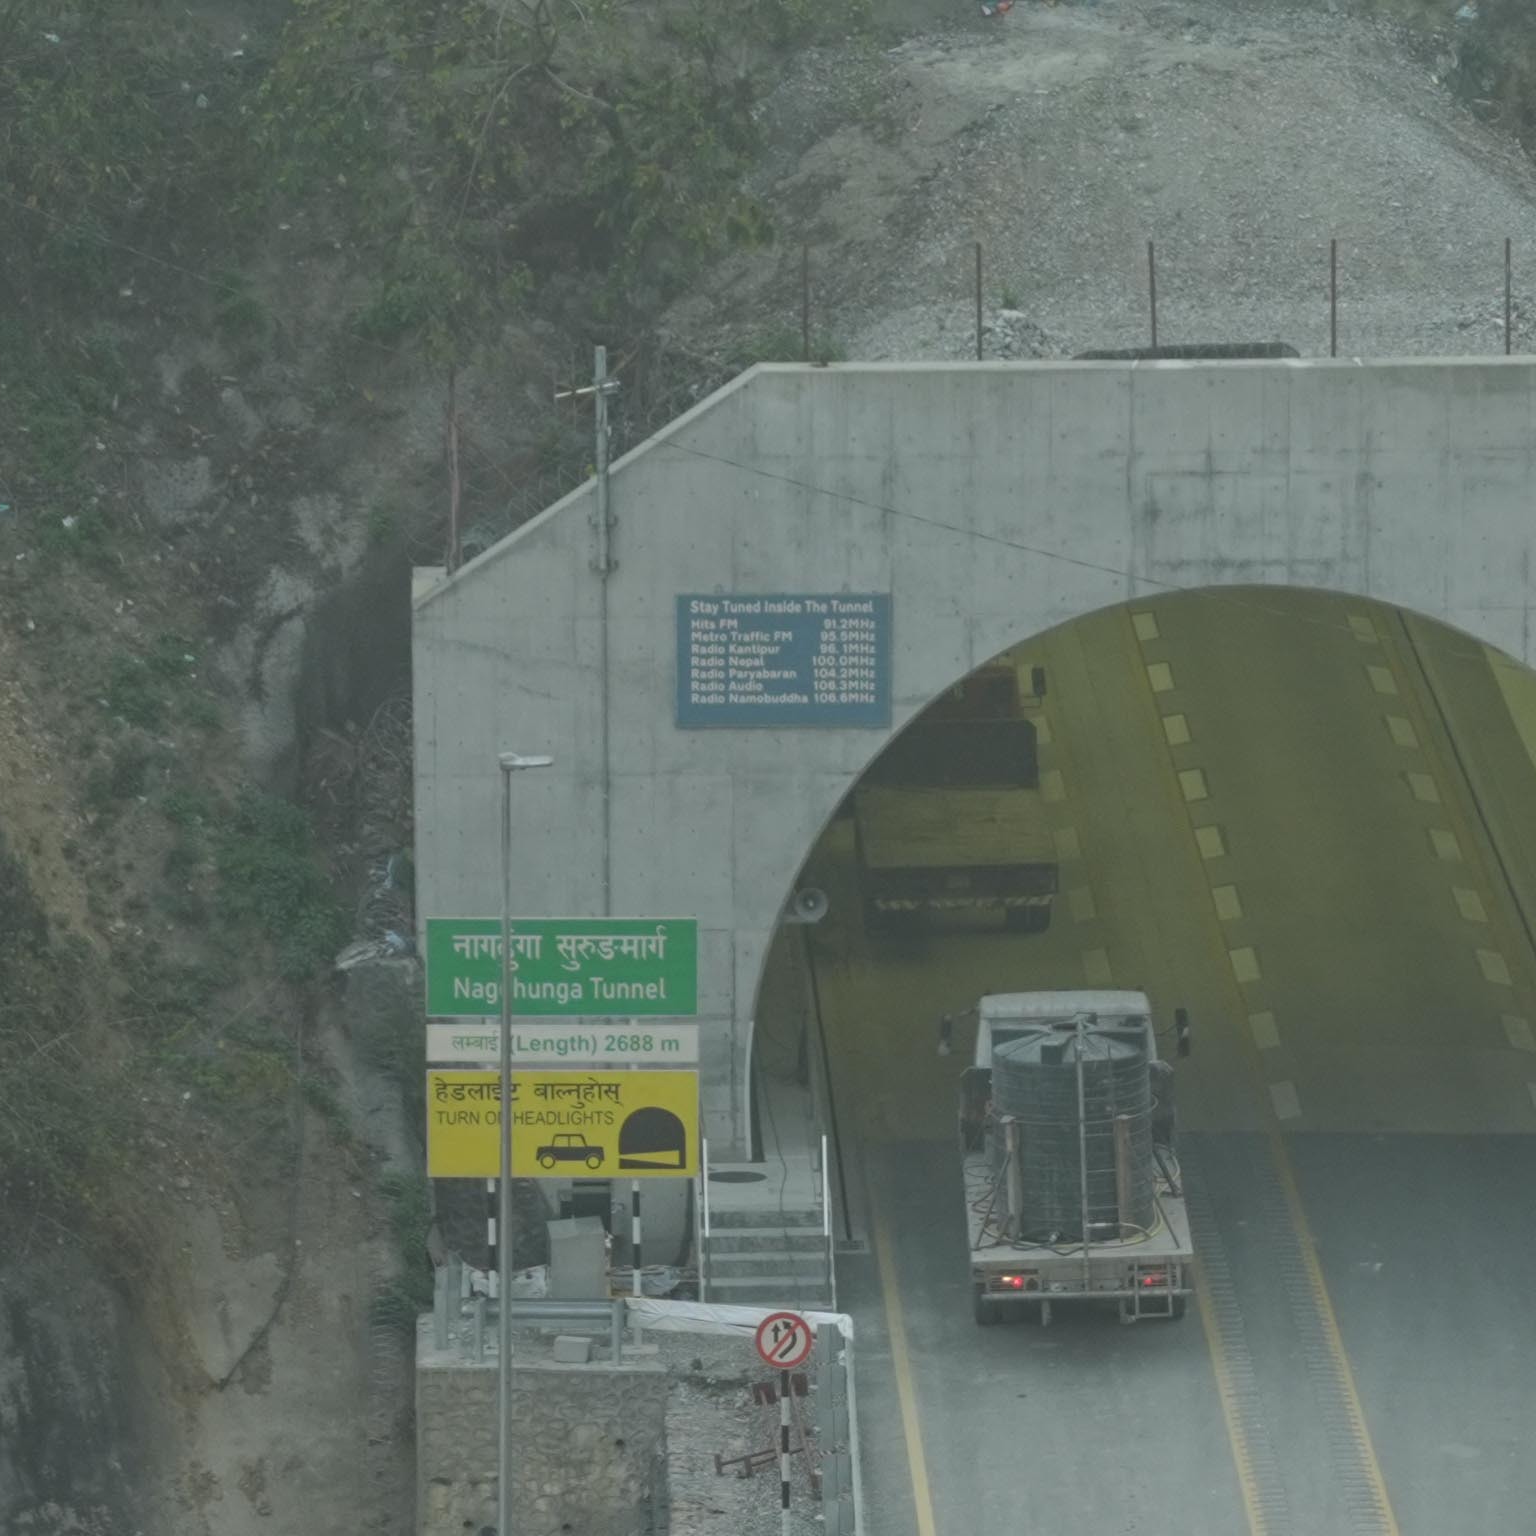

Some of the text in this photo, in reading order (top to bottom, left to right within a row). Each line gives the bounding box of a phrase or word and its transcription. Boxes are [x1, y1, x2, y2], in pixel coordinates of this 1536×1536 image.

[690, 600, 874, 615] Stay Tuned Inside The Tunnel
[690, 618, 715, 630] Hits
[719, 618, 739, 630] FM
[690, 631, 727, 643] Metro
[730, 631, 770, 643] Traffic
[773, 631, 793, 643] FM
[690, 643, 725, 655] Radio
[728, 643, 781, 657] Kantipur
[690, 655, 725, 667] Radio
[728, 655, 765, 669] Nepal
[690, 668, 725, 680] Radio
[728, 668, 798, 682] Paryabaran
[690, 680, 725, 692] Radio
[728, 680, 764, 692] Audio
[690, 693, 725, 704] Radio
[728, 693, 809, 704] Namobuddha
[453, 976, 667, 1004] Naghunga Tunnel
[510, 1033, 598, 1055] (Length)
[604, 1034, 654, 1052] 2688
[660, 1038, 680, 1052] m
[436, 1110, 481, 1125] TURN
[513, 1110, 615, 1126] HEADLIGHTS
